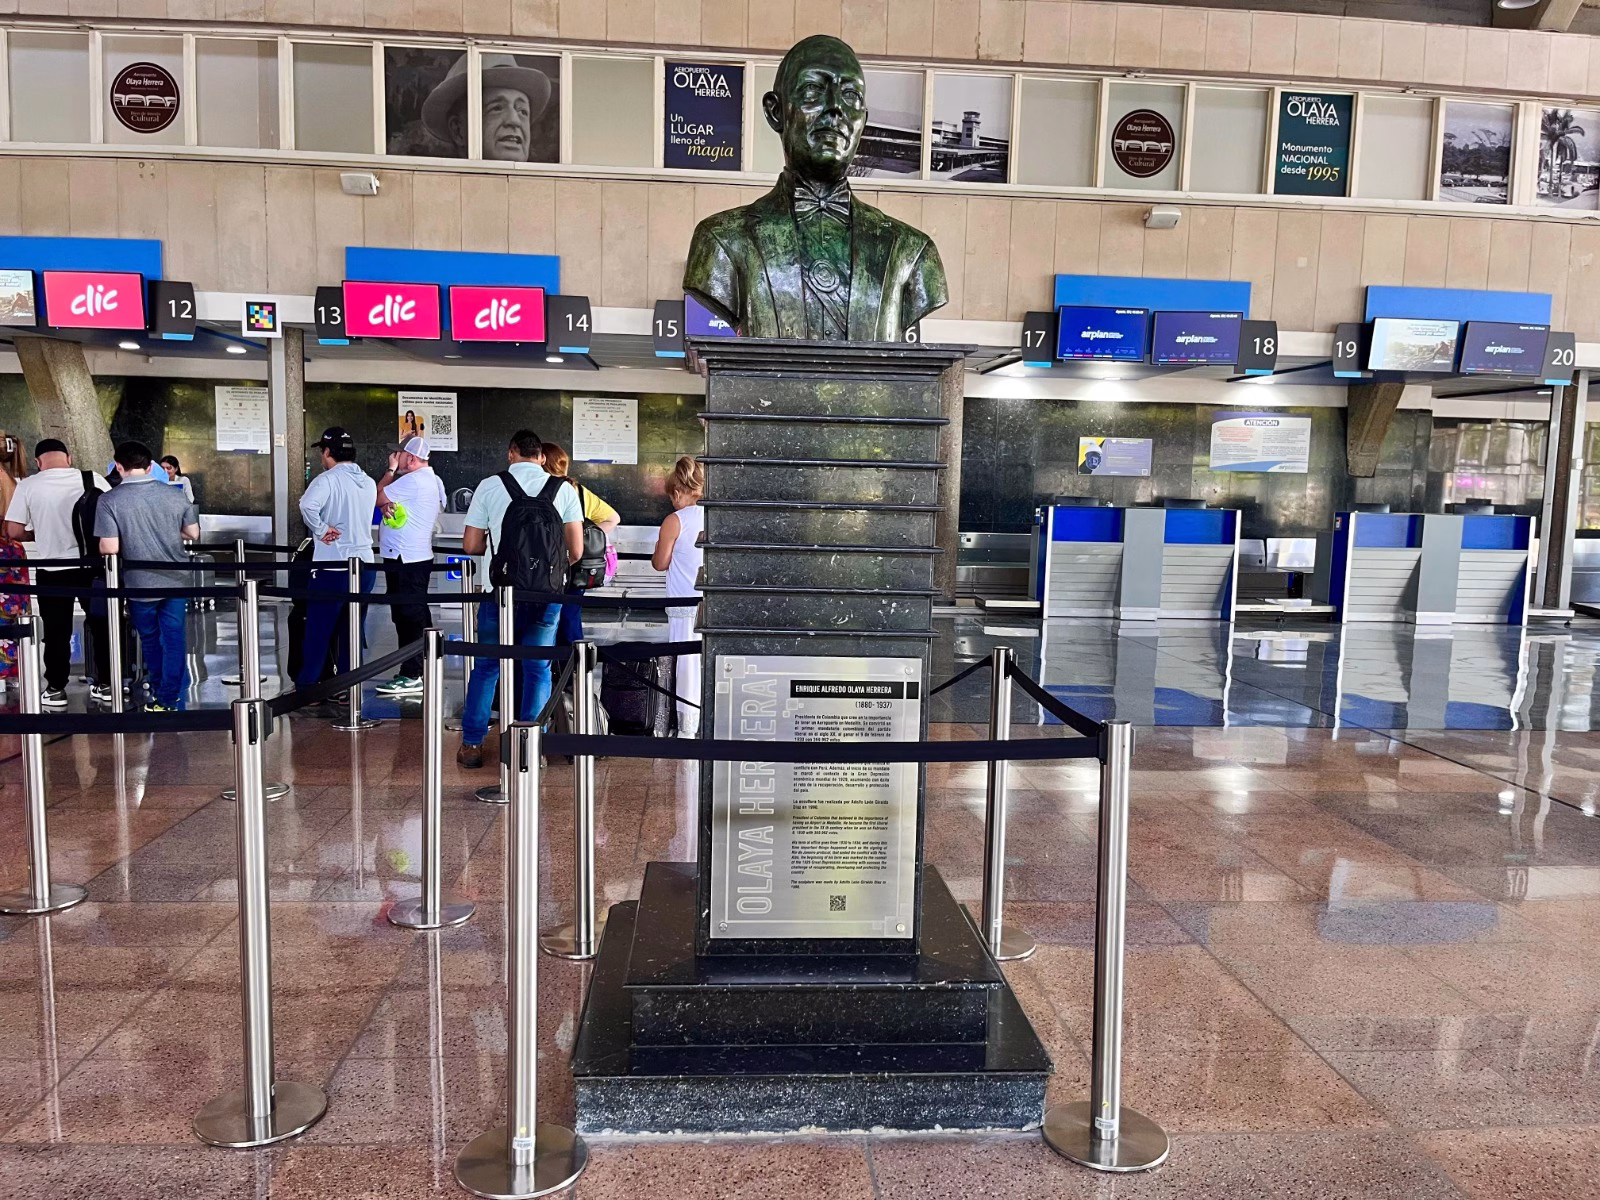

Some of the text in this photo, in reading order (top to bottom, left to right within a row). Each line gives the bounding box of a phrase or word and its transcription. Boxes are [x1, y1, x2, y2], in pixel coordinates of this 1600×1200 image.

[126, 78, 164, 86] Olaya Herrera
[674, 72, 728, 90] OLAYA
[694, 88, 732, 98] HERRERA
[670, 113, 684, 122] Un
[1287, 101, 1338, 118] OLAYA
[671, 123, 714, 135] LUGAR
[1306, 116, 1340, 126] HERRERA
[670, 135, 706, 145] lleno de
[1282, 142, 1332, 153] Monumento
[688, 140, 734, 162] magia
[1282, 154, 1328, 164] NACIONAL
[1281, 165, 1340, 181] desde 1995
[70, 284, 118, 316] clic
[168, 300, 192, 318] 12
[318, 306, 342, 325] 13
[368, 294, 416, 326] clic
[474, 298, 521, 330] clic
[565, 314, 589, 332] 14
[656, 319, 678, 337] 15
[905, 326, 917, 343] 6
[1024, 330, 1046, 348] 17
[1081, 326, 1109, 340] airplan
[1175, 331, 1203, 345] airplan
[1253, 337, 1275, 355] 18
[1336, 341, 1357, 358] 19
[1485, 341, 1511, 355] airplan
[1552, 348, 1574, 366] 20
[796, 685, 820, 693] ENRIQUE
[736, 679, 777, 914] OLAYA HERERA
